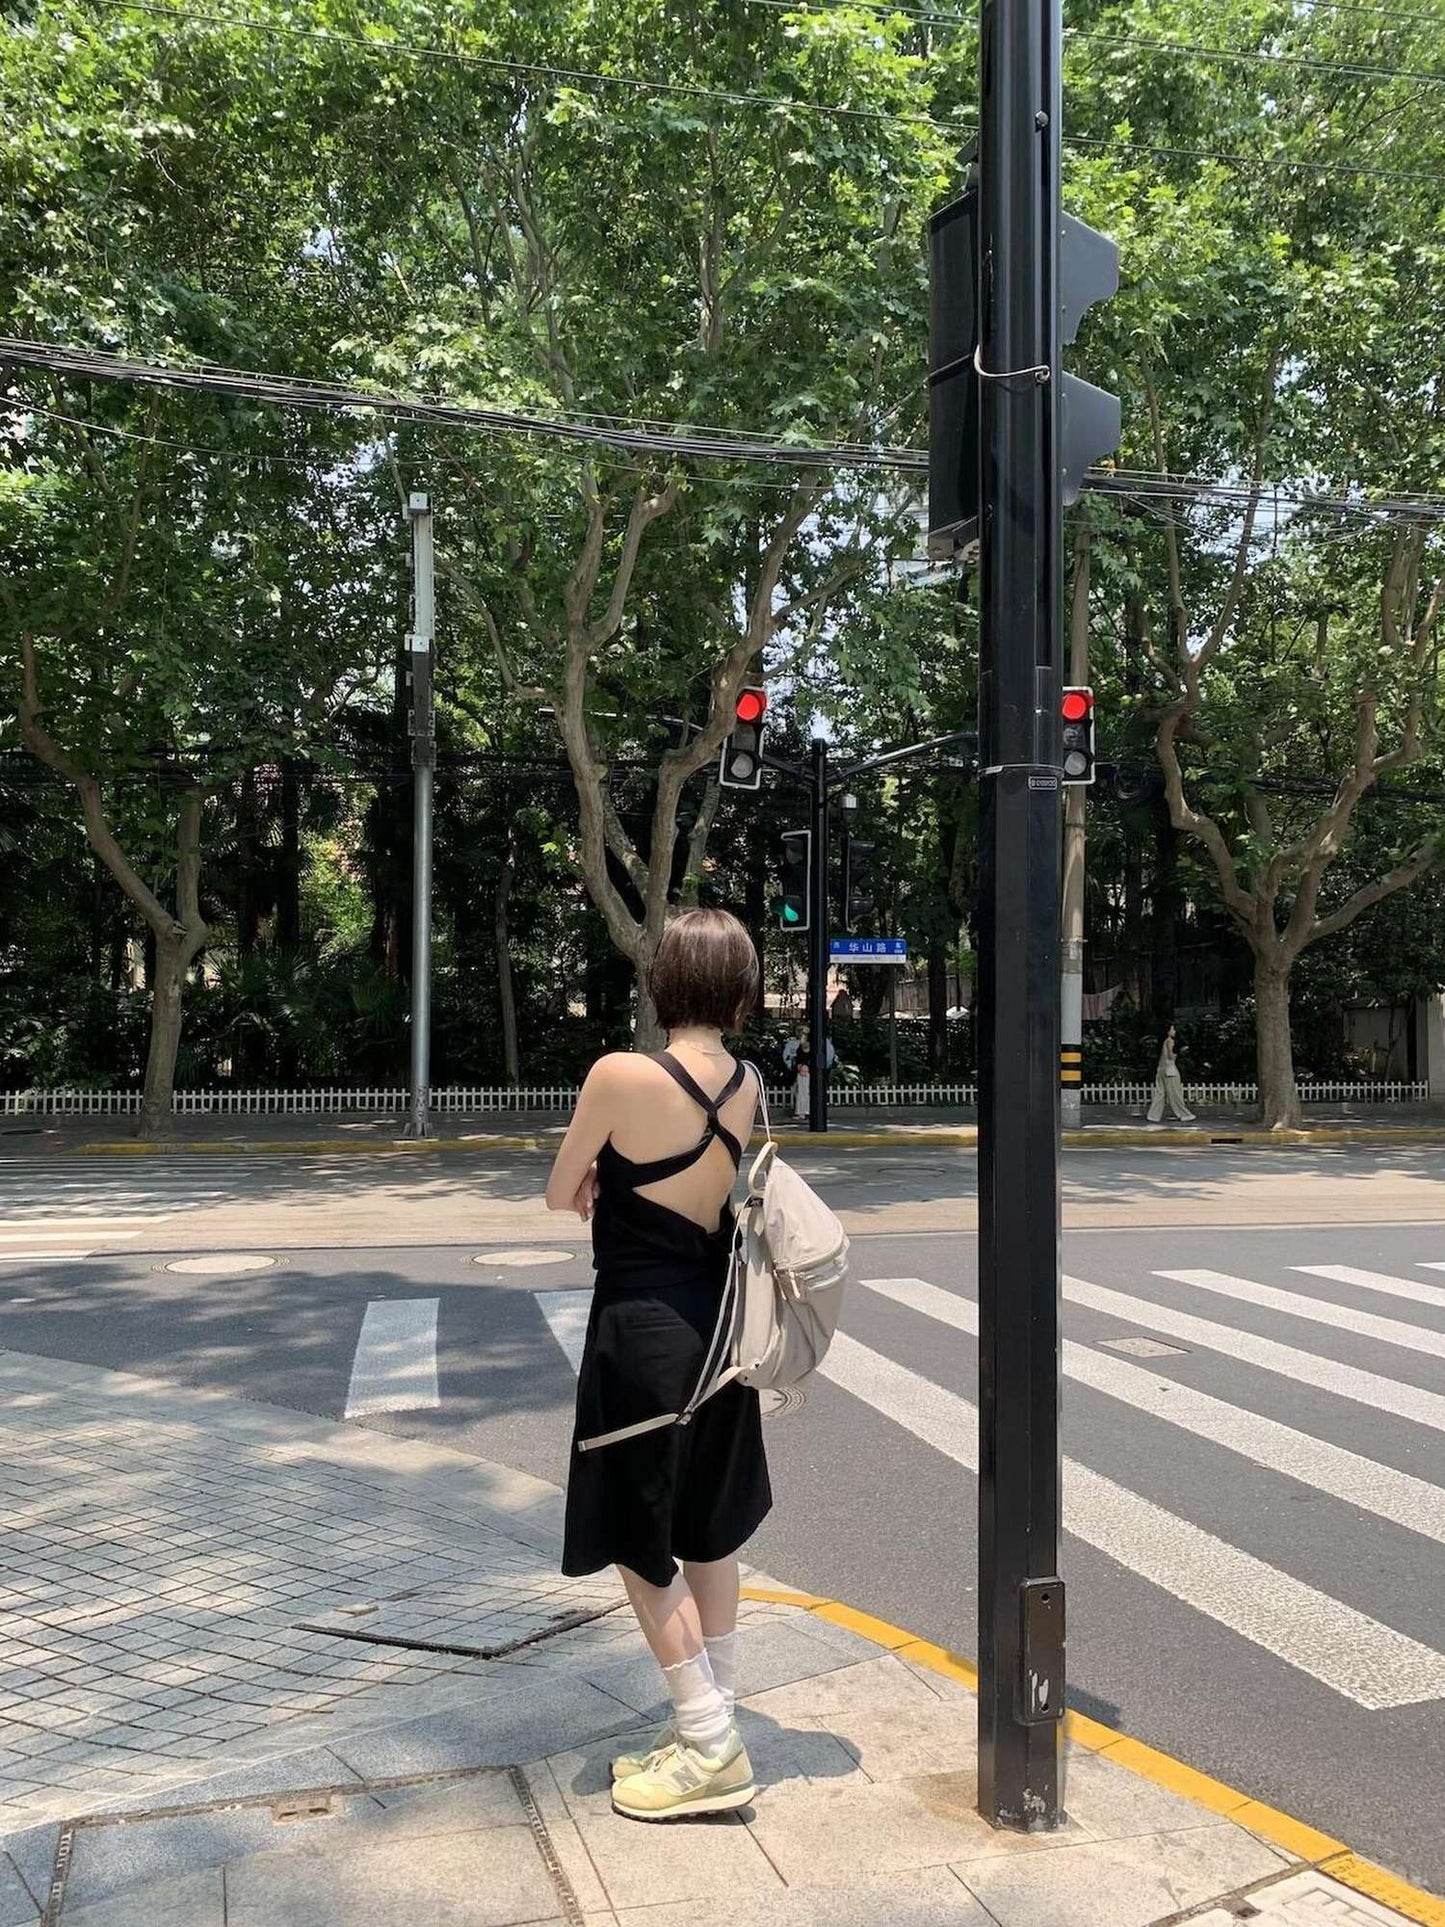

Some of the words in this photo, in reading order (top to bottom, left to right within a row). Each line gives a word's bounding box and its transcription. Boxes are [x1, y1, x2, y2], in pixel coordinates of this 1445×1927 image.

[848, 942, 887, 953] 华山路
[673, 1765, 703, 1792] N
